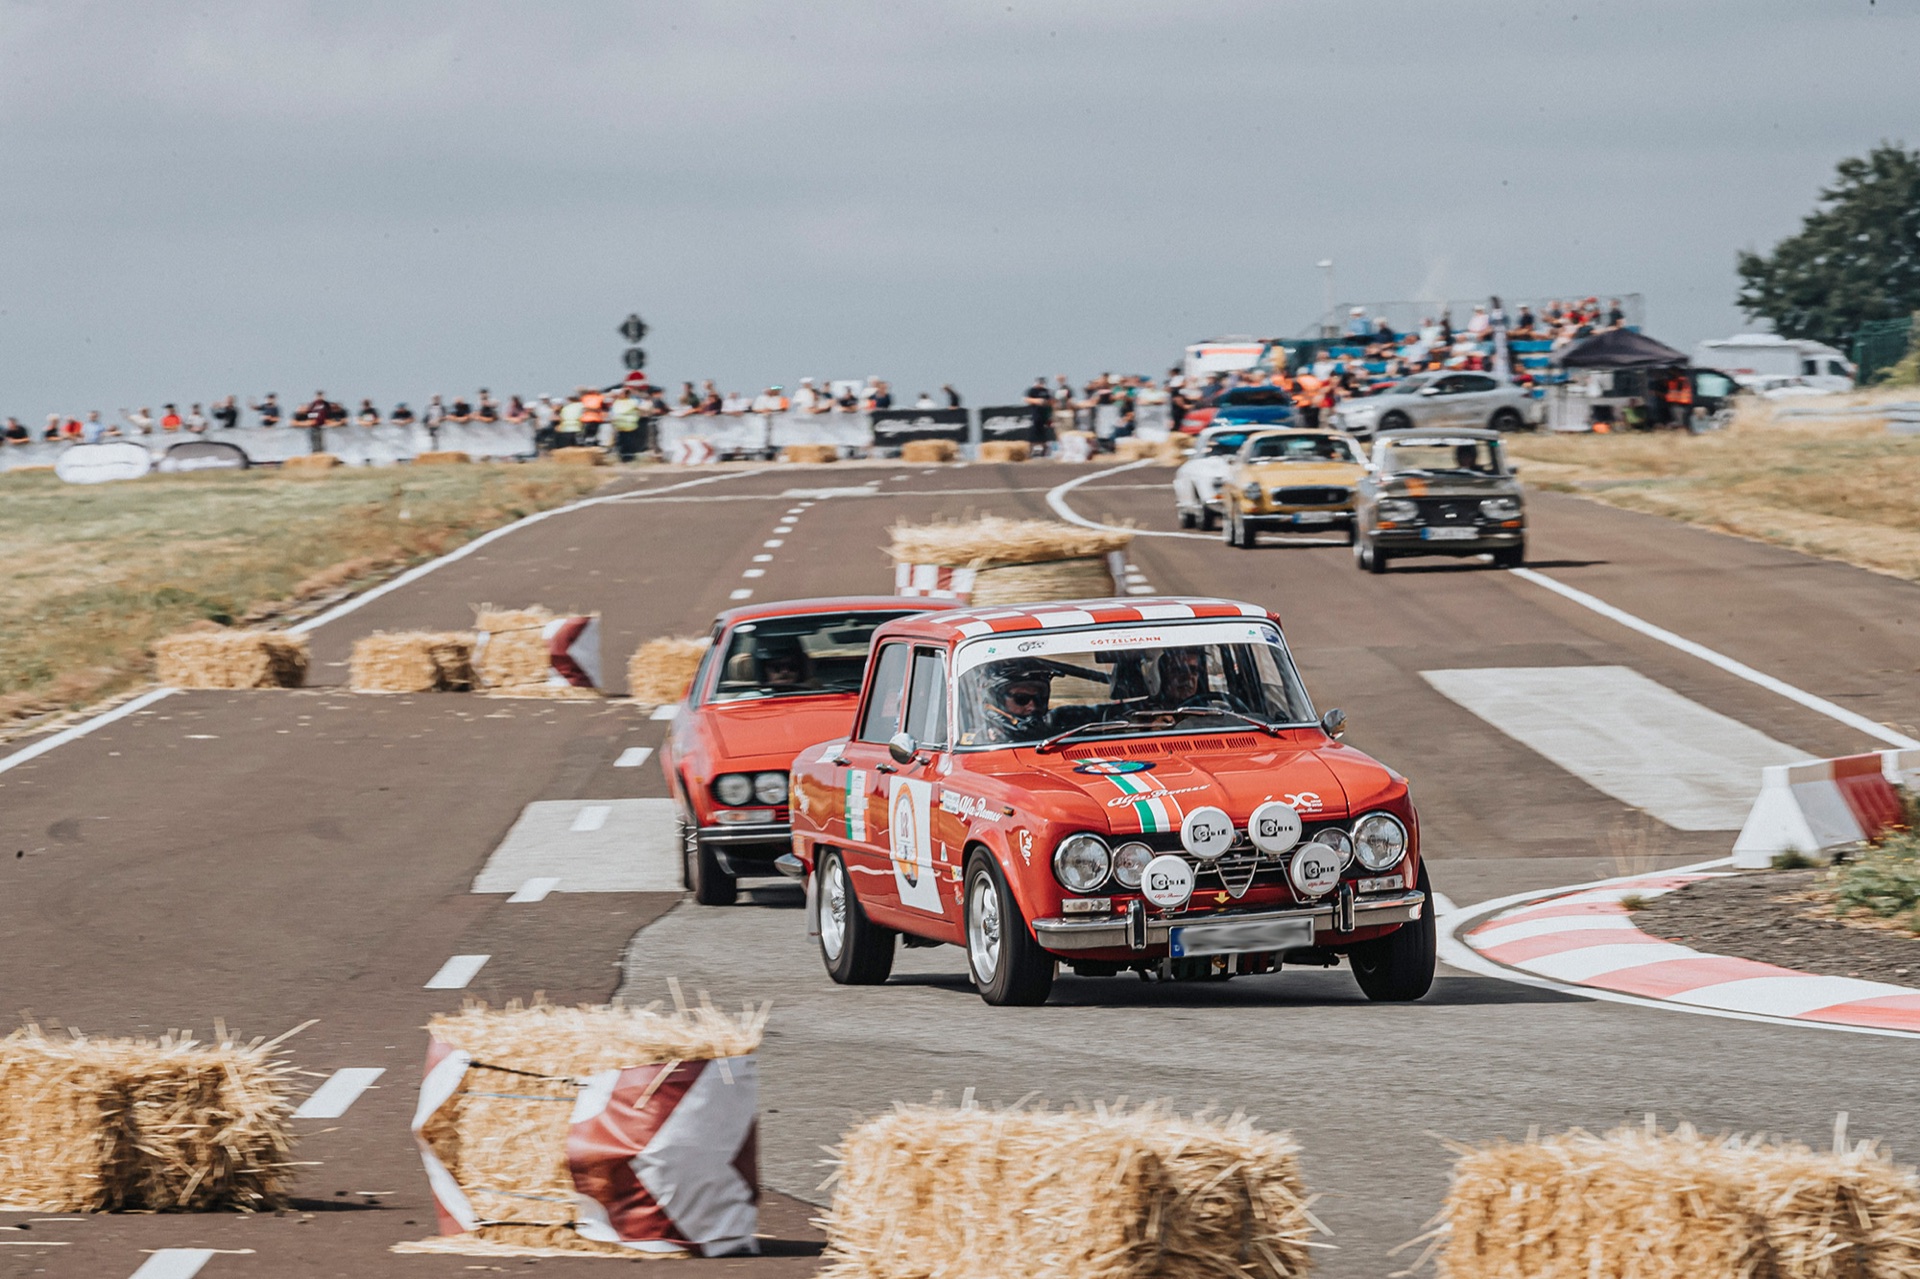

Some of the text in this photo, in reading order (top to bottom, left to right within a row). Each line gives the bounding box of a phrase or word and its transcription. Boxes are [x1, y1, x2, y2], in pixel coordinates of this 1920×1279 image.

[959, 795, 976, 822] Alfa
[975, 797, 1003, 822] Romeo
[1107, 784, 1211, 809] Alfa Romeo
